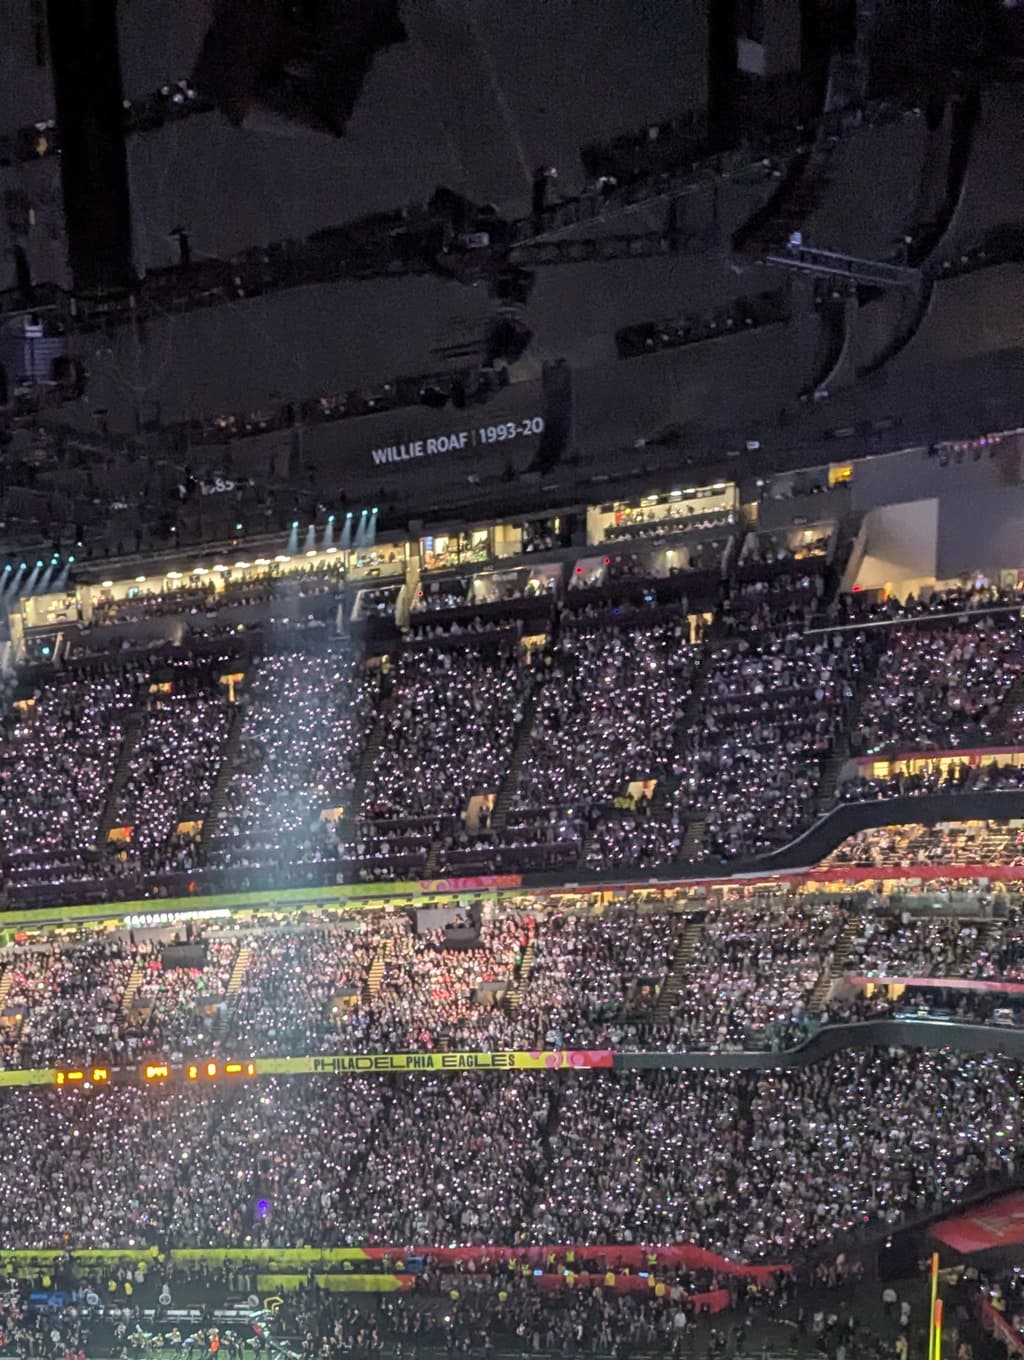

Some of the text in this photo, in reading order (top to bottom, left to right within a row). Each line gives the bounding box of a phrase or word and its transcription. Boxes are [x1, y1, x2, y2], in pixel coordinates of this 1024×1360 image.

[372, 417, 544, 464] WILLIE ROAF 1993-20
[313, 1054, 515, 1071] PHILADELPHIA EAGLES
